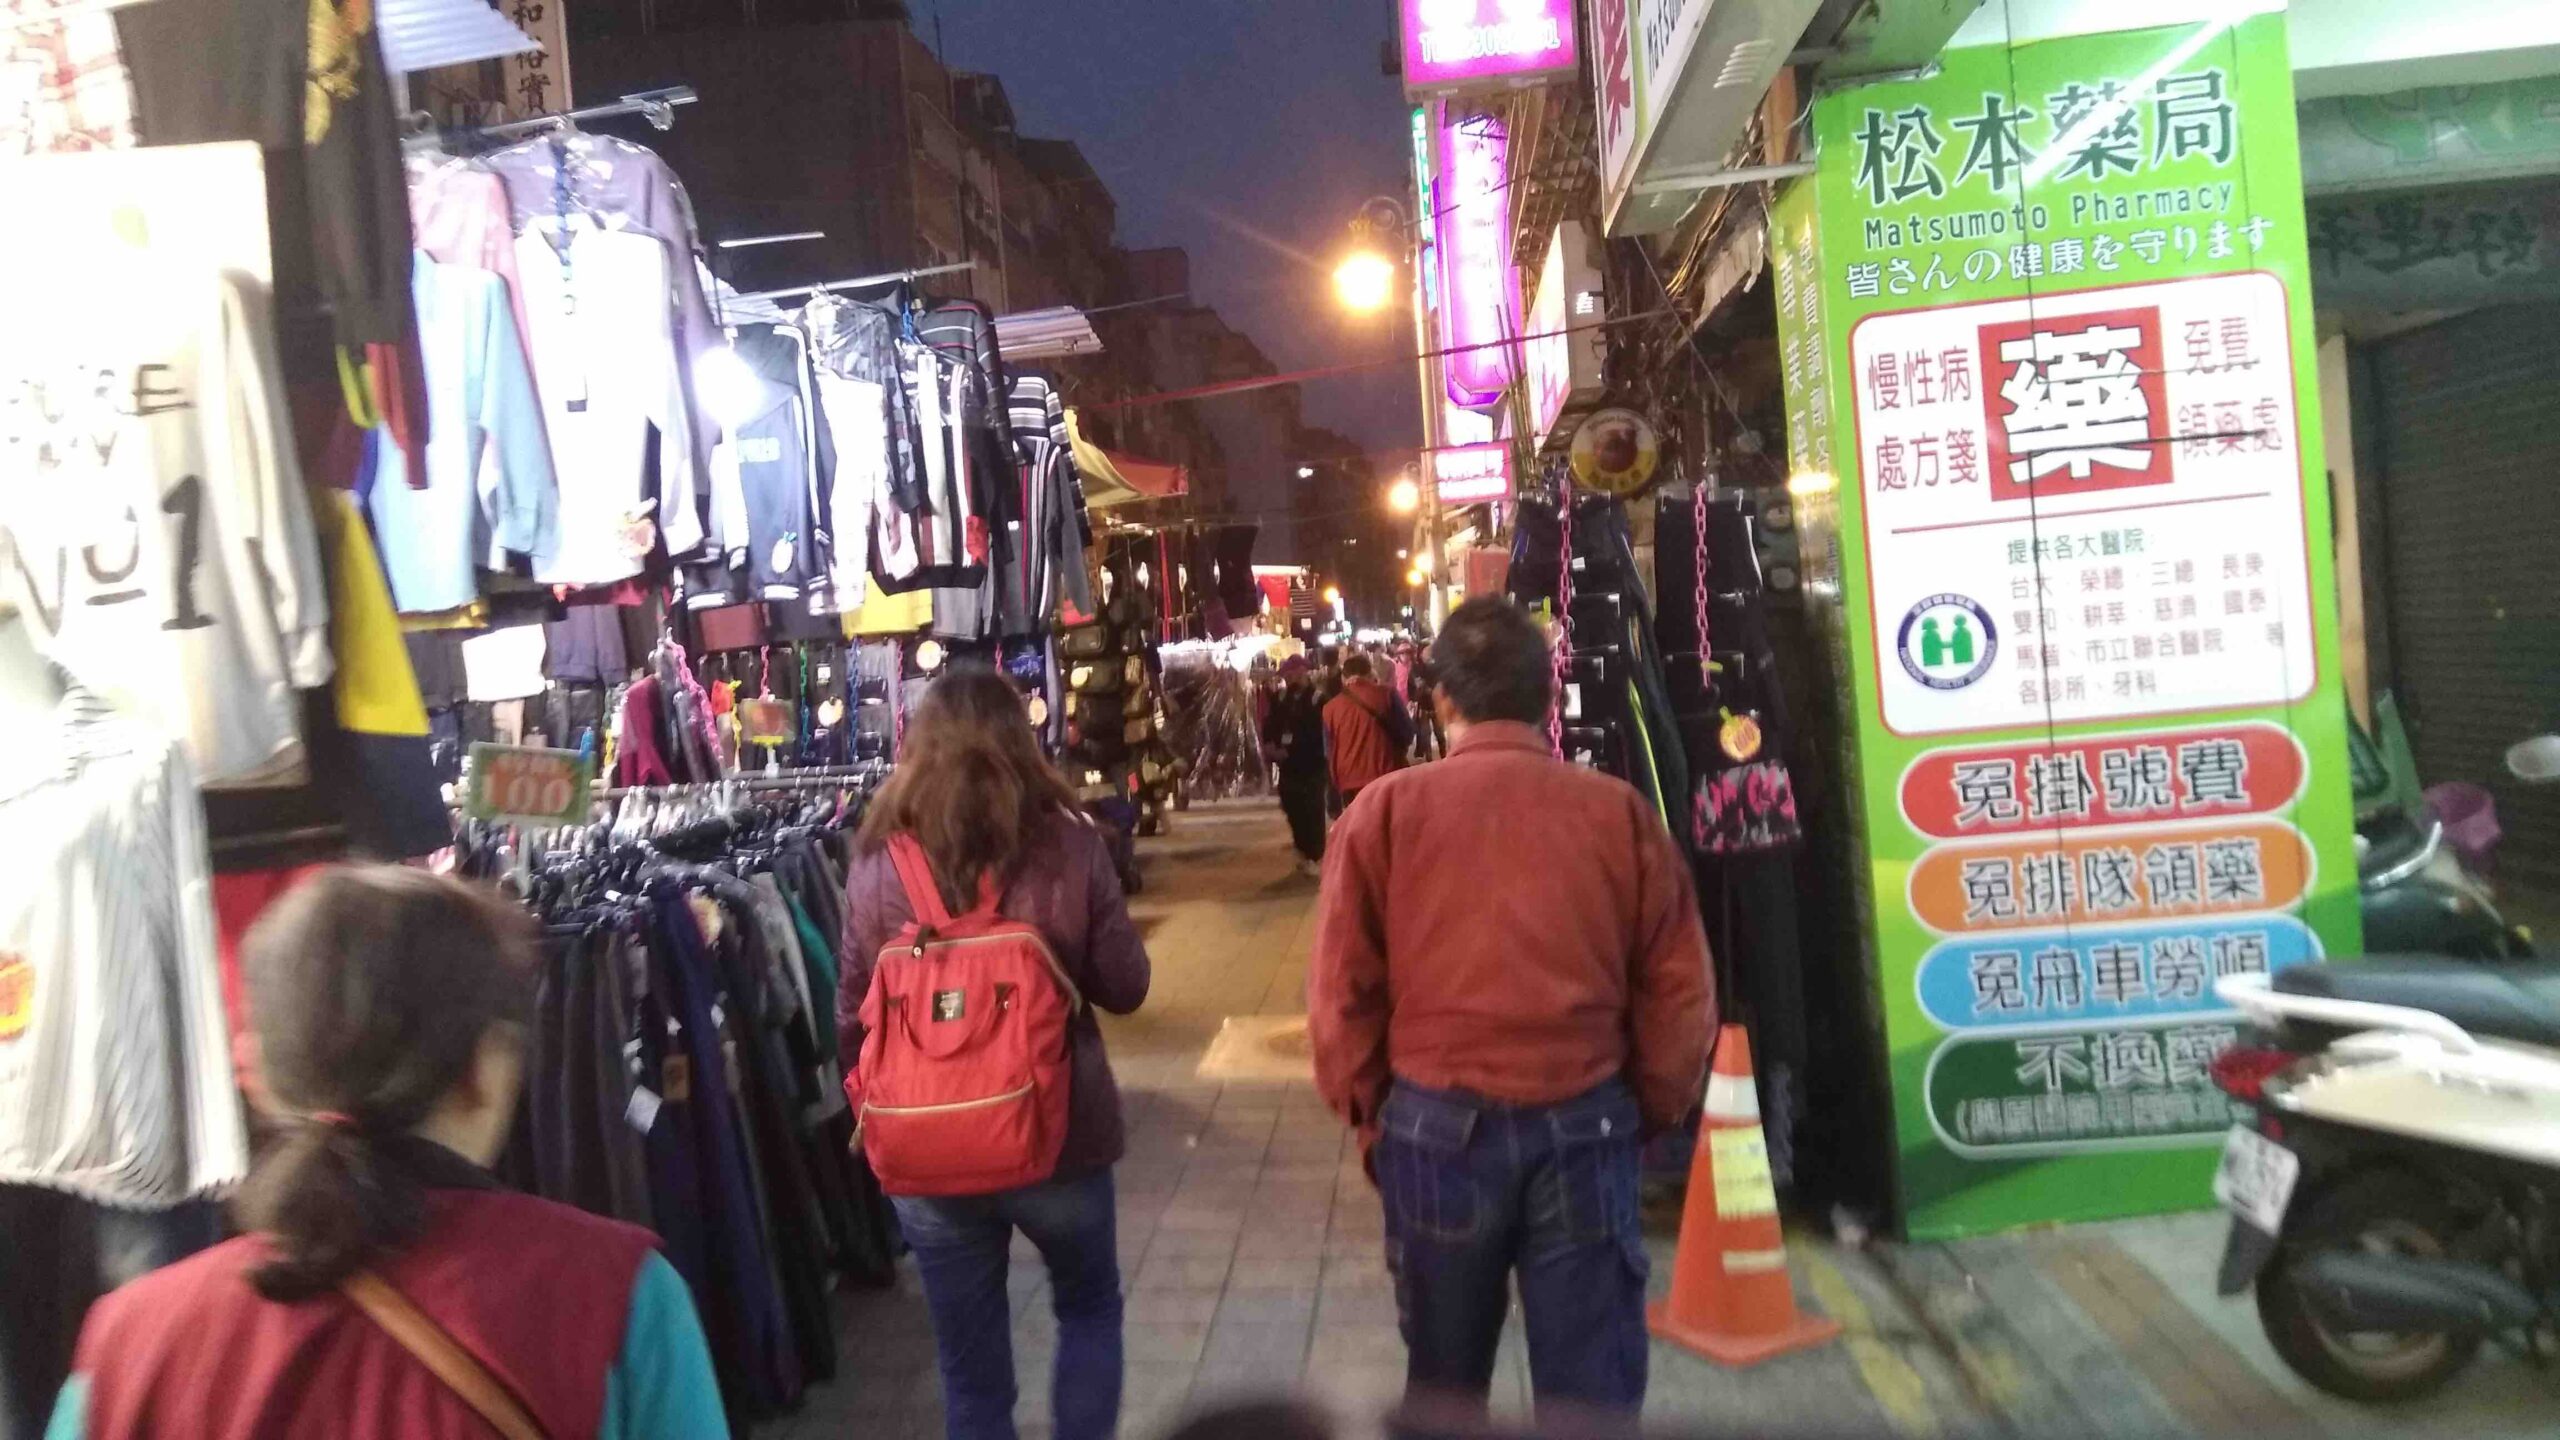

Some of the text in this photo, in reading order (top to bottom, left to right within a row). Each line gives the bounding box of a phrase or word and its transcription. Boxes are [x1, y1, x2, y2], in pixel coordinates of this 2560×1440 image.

[1855, 69, 2236, 205] 松本藥局
[1865, 180, 2233, 251] Matsumoto Pharmacy
[1845, 216, 2275, 301] 皆さんの健康を守ります
[1868, 344, 1973, 413] 慢性病
[2000, 323, 2153, 484] 藥
[1875, 427, 1980, 494] 處方箋
[1954, 739, 2248, 827] 免掛號費
[1962, 838, 2263, 924] 免排隊領藥
